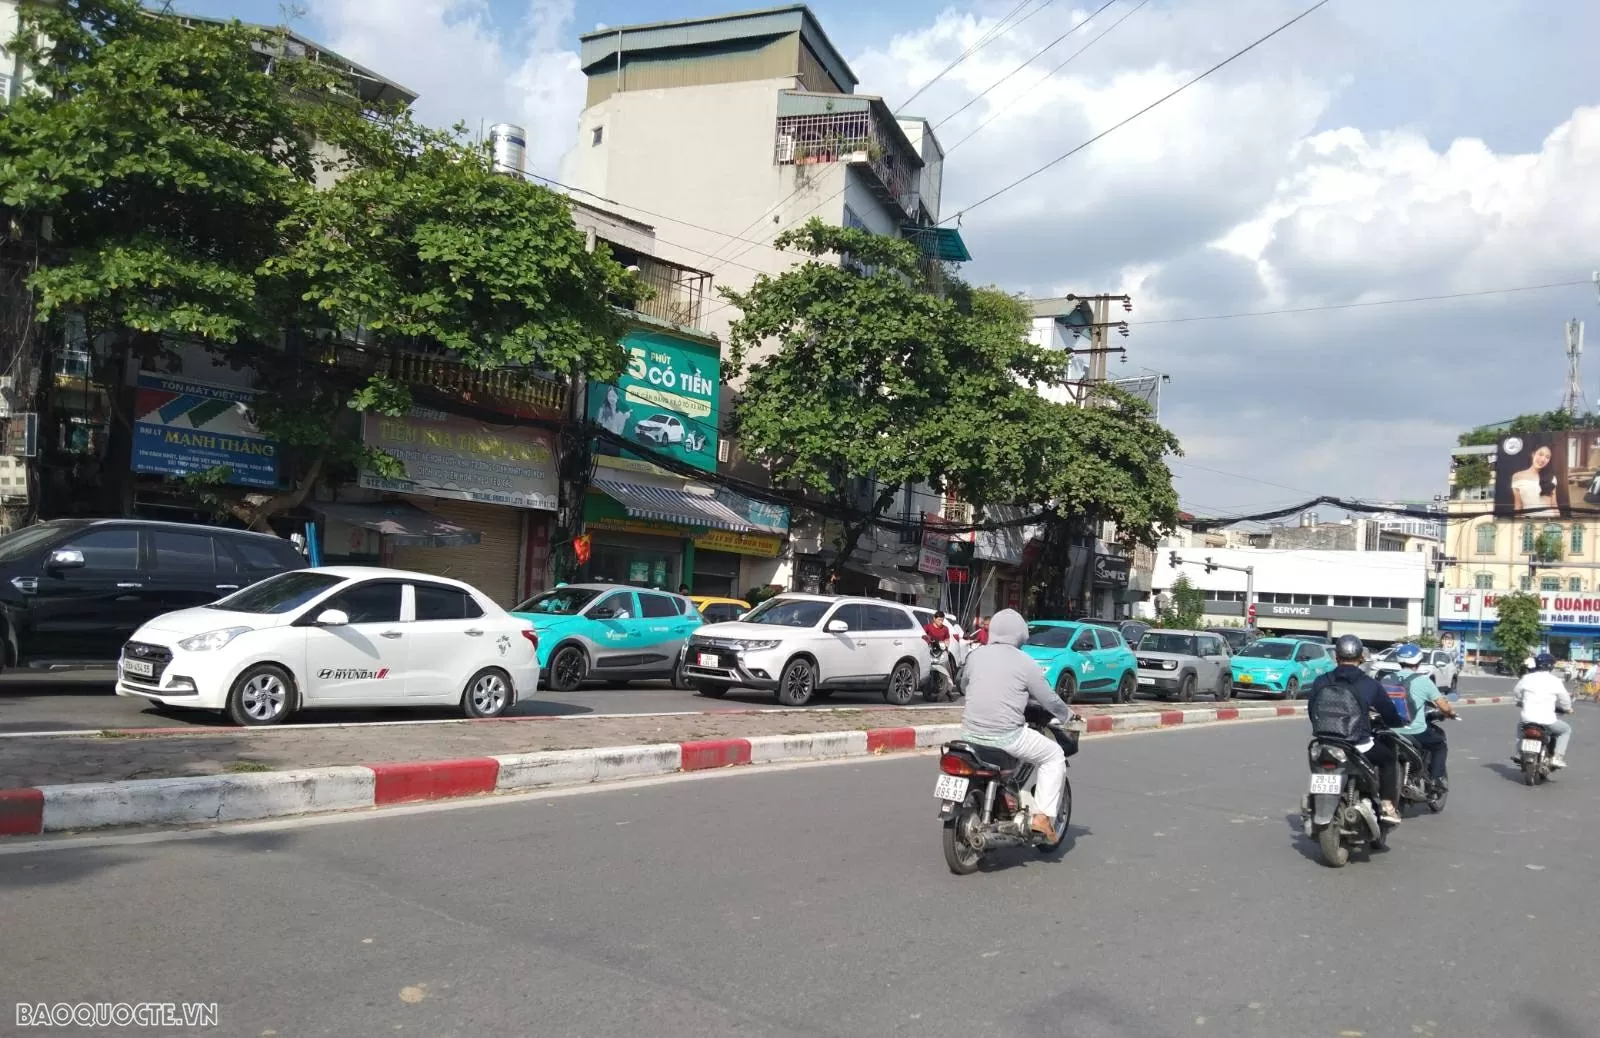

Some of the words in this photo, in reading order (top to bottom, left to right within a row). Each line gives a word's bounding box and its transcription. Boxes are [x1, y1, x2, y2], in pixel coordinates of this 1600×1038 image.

[619, 345, 647, 379] 5
[651, 351, 672, 364] PHÚT
[648, 366, 676, 388] CÓ
[680, 368, 712, 396] TIỀN
[165, 430, 216, 448] MẠNH
[1272, 606, 1310, 614] SERVICE
[334, 671, 378, 680] HYUNDAI
